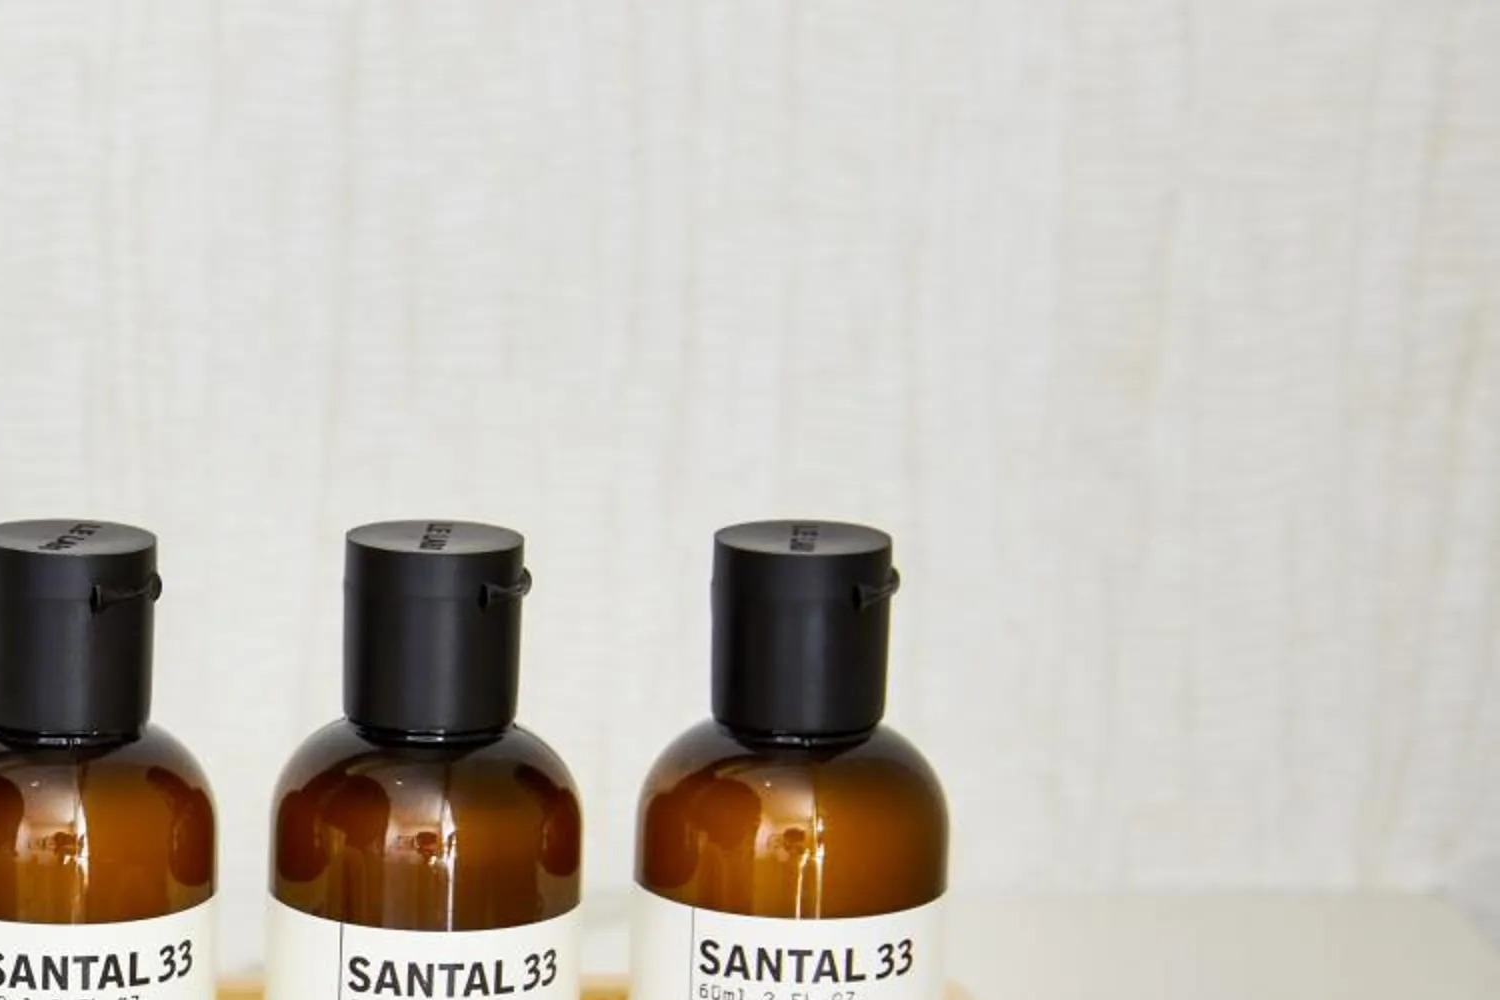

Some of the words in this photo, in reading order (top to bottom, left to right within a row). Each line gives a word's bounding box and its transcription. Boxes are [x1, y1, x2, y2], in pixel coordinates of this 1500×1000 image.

[157, 938, 194, 983] 33
[347, 955, 516, 998] SANTAL
[522, 948, 558, 992] 33
[699, 939, 867, 984] SANTAL
[875, 938, 914, 980] 33
